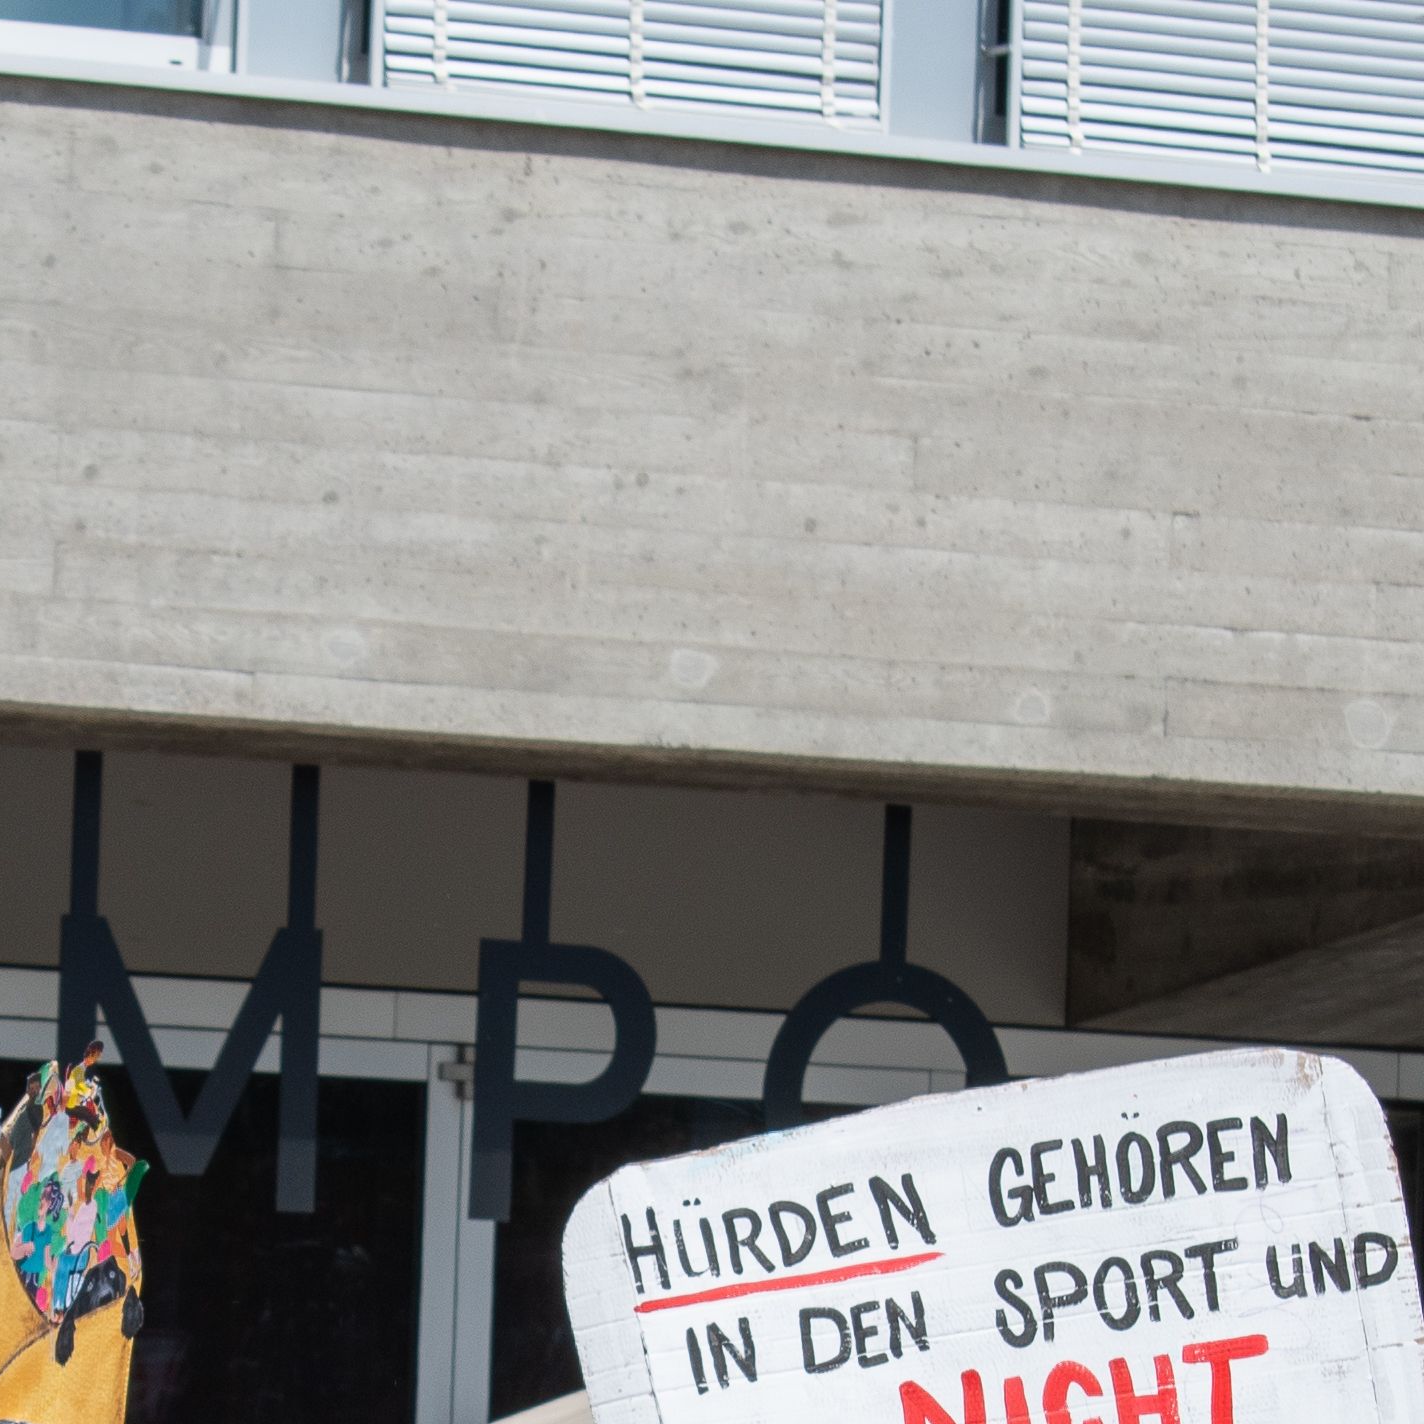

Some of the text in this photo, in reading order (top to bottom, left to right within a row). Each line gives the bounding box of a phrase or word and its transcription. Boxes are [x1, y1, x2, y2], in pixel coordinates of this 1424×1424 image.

[621, 1111, 1293, 1294] HÜRDEN GEHÖREN
[686, 1231, 1399, 1394] IN DEN SPORT UND
